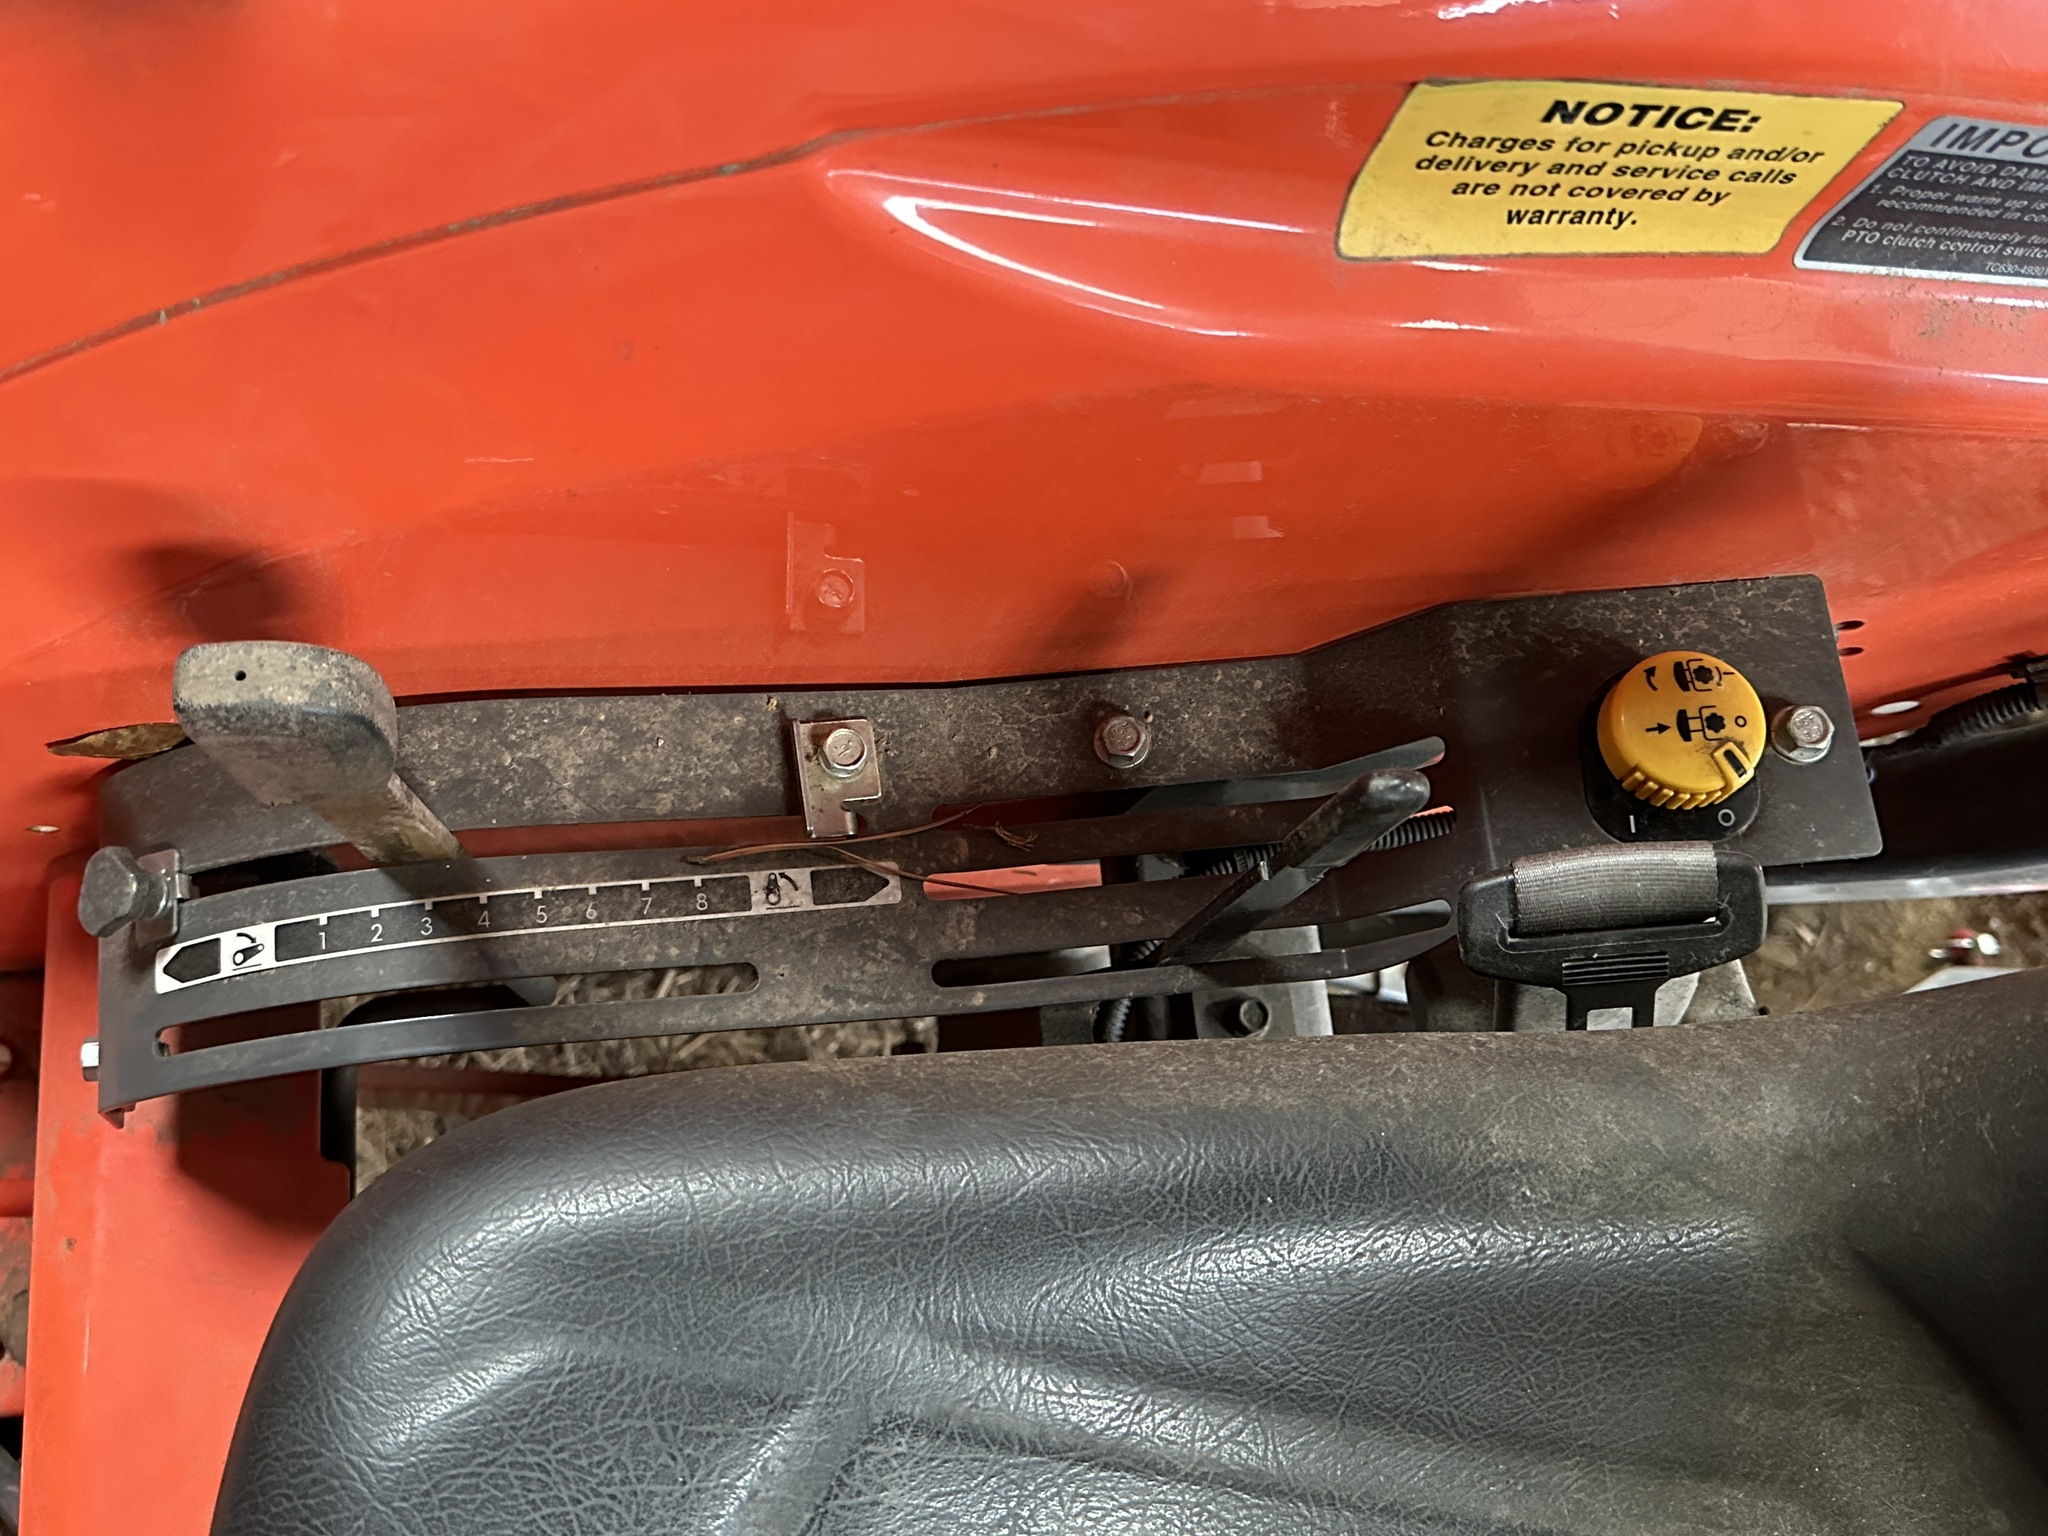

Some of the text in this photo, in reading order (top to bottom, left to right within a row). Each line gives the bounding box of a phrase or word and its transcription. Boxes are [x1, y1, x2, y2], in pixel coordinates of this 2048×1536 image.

[1540, 100, 1761, 133] NOTICE:
[1426, 130, 1824, 163] Charges for pickup and/or
[1415, 153, 1797, 184] delivery and service calls
[1902, 155, 1930, 168] TO
[1932, 159, 1997, 174] AVOID
[1887, 168, 1970, 185] CLUTCH
[1970, 177, 2016, 190] AND
[1452, 182, 1731, 206] are not covered by
[1870, 184, 1883, 194] 1.
[1889, 185, 1951, 201] Proper
[1954, 194, 2002, 206] warm
[2004, 200, 2029, 210] up
[1507, 207, 1637, 230] warranty.
[1877, 199, 2004, 218] recommended
[2002, 210, 2021, 220] in
[1831, 216, 1846, 226] 2.
[1852, 217, 1878, 229] Do
[1881, 222, 1913, 232] not
[1914, 225, 2026, 244] continuously
[1841, 230, 2048, 258] PTO clutch control switc
[319, 893, 708, 950] 1 2 3 4 5 6 7 8
